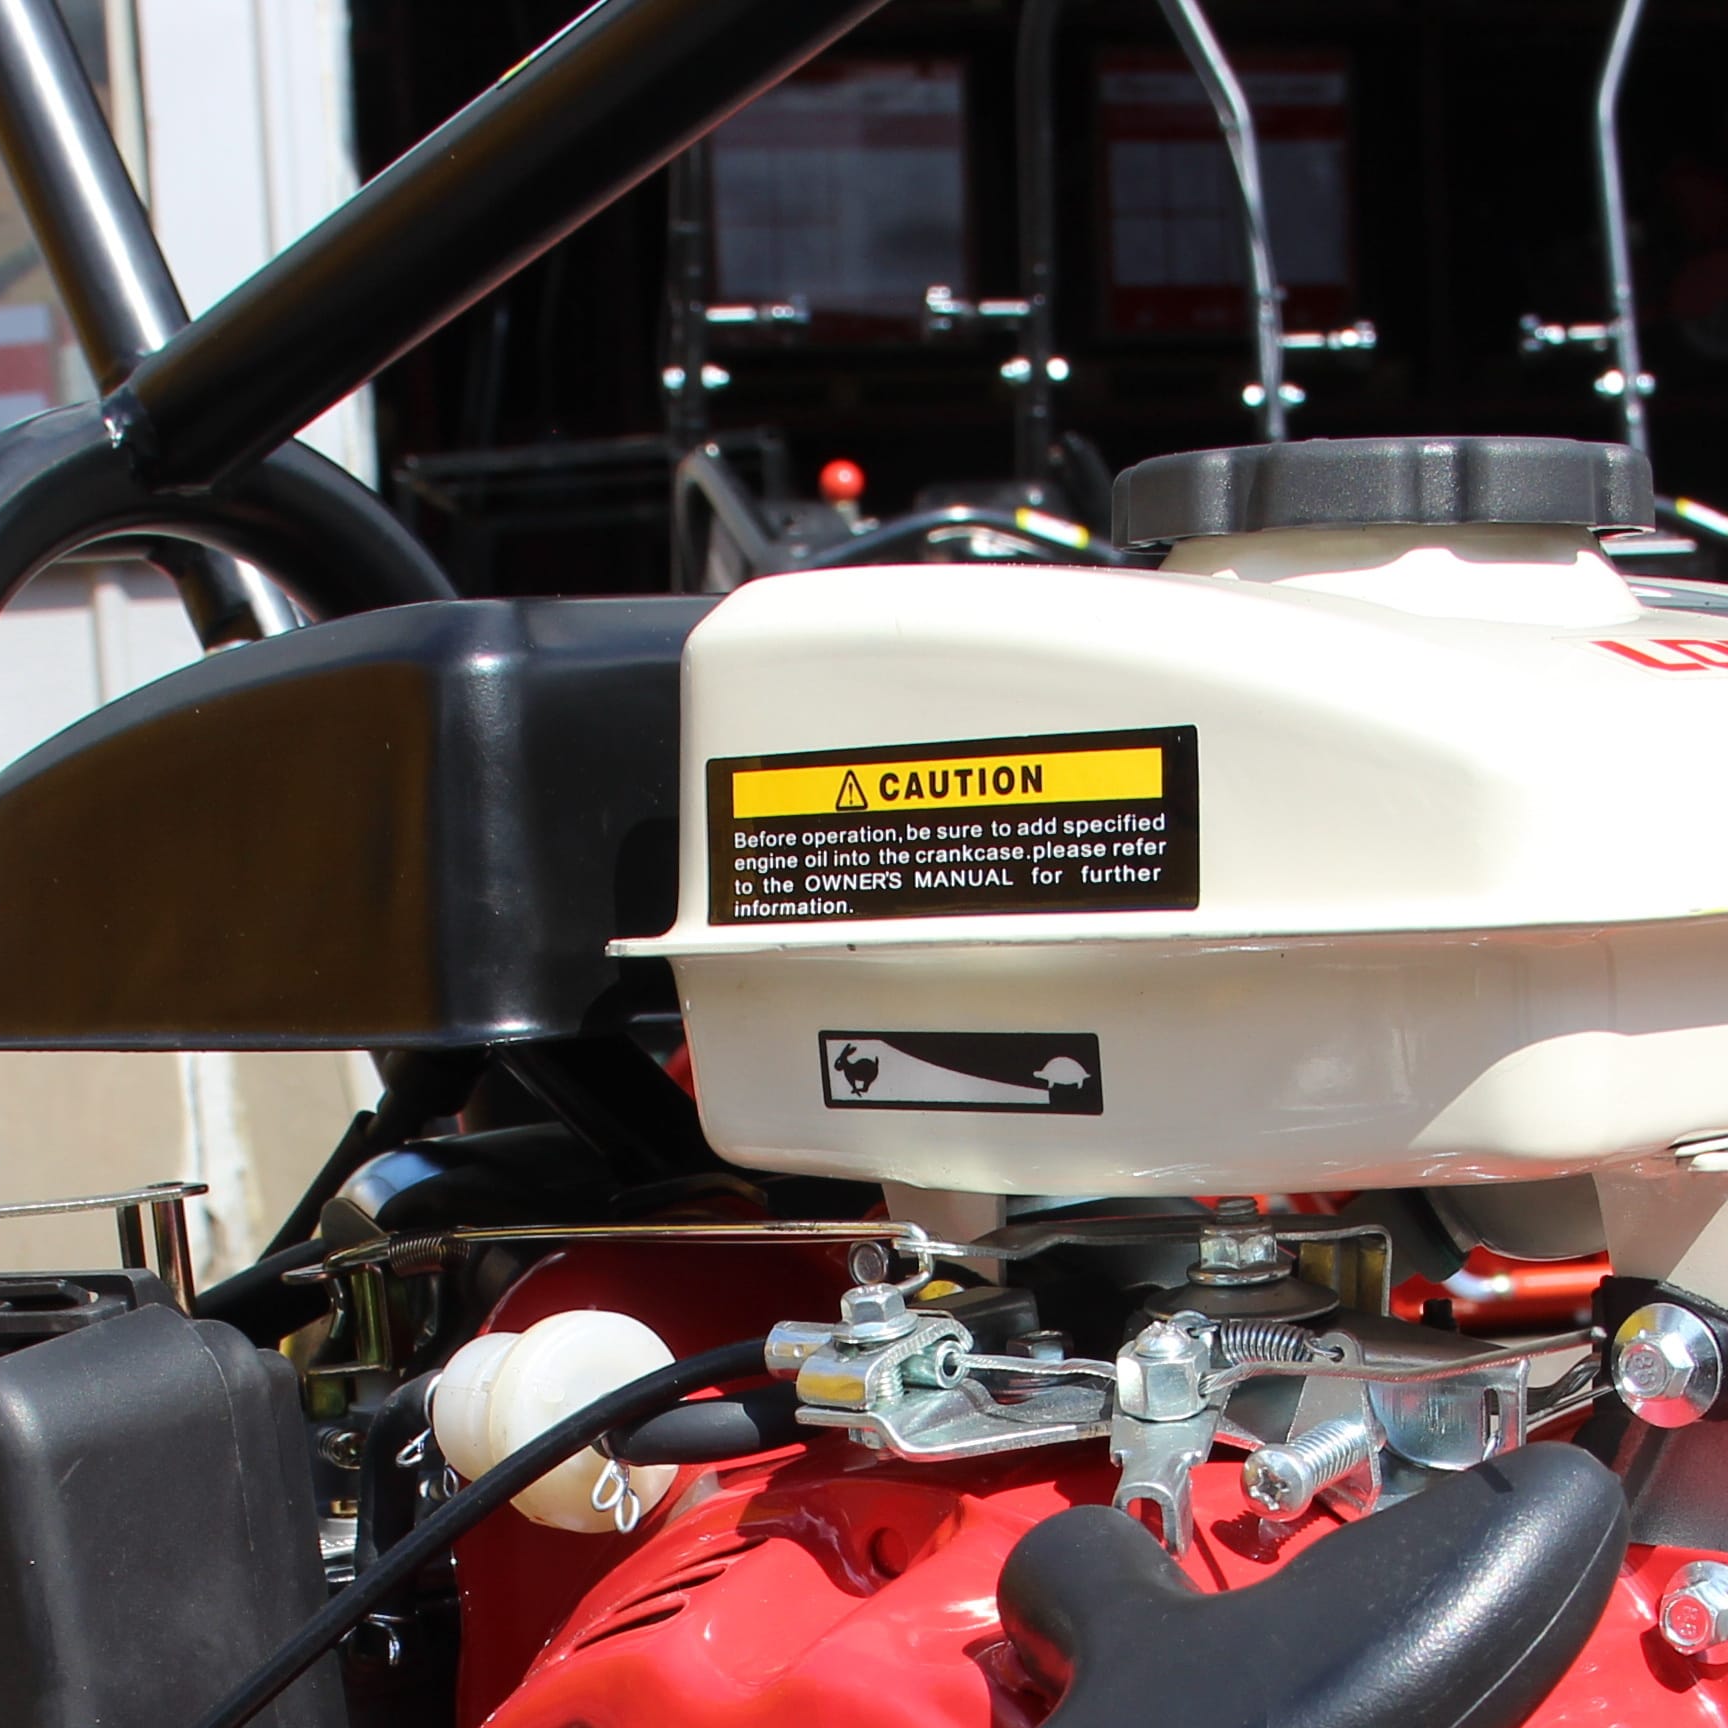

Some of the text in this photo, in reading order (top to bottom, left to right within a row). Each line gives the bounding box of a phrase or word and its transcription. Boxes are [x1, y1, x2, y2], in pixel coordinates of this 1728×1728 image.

[879, 764, 1043, 802] CAUTION
[734, 831, 797, 849] Before
[936, 824, 983, 840] sure
[991, 820, 1011, 838] to
[1017, 816, 1057, 836] add
[1063, 812, 1166, 838] specified
[734, 852, 798, 874] engine
[805, 850, 828, 869] oil
[834, 850, 870, 867] into
[879, 848, 910, 865] the
[1113, 838, 1167, 857] refer
[735, 864, 1162, 895] to the OWNER'S MANUAL for further
[734, 897, 854, 917] information.
